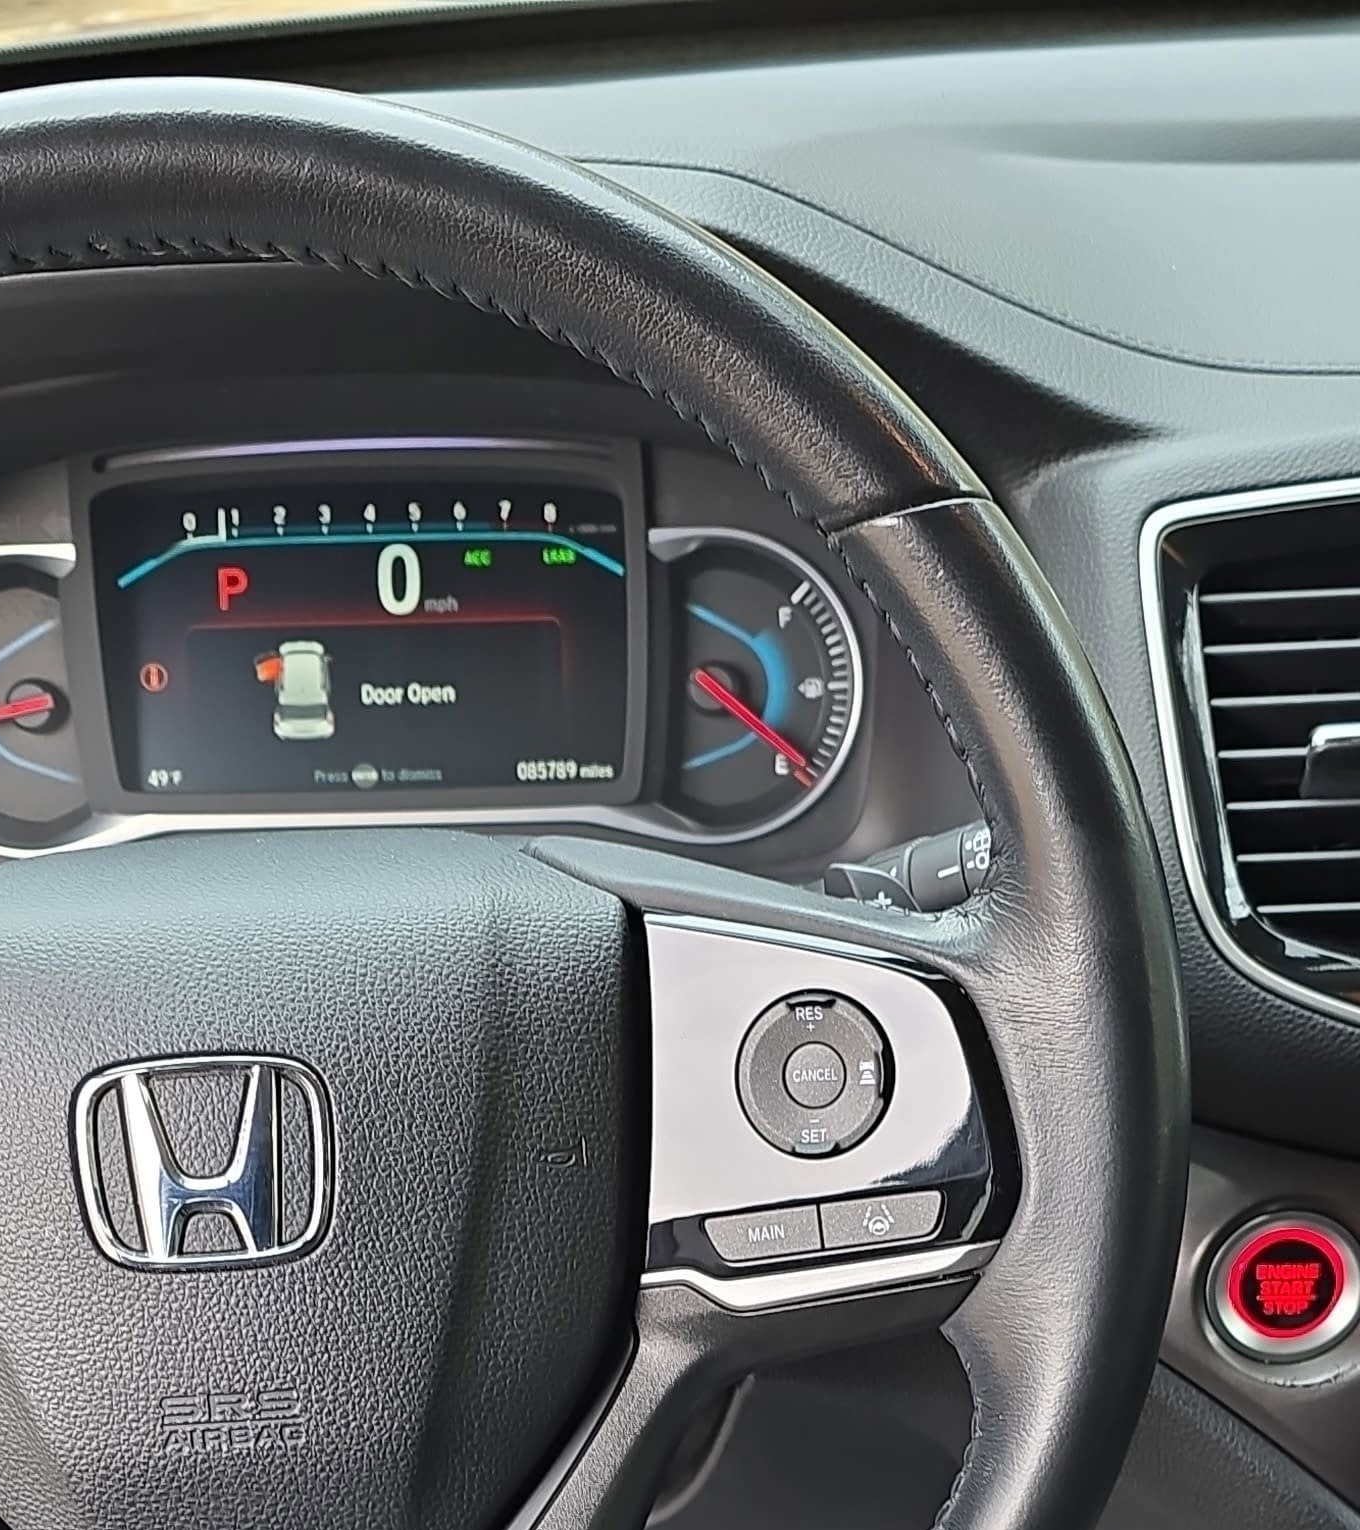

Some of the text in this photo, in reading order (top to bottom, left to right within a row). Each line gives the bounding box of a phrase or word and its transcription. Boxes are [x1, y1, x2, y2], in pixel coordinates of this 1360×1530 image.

[183, 511, 197, 530] 0
[273, 505, 287, 525] 2
[318, 504, 332, 524] 3
[363, 503, 377, 523] 4
[453, 502, 467, 521] 6
[498, 500, 512, 521] 7
[217, 567, 249, 611] P
[377, 543, 422, 616] 0
[778, 606, 792, 629] F
[361, 682, 456, 707] Door Open
[516, 759, 614, 782] 085789 miles
[775, 753, 789, 775] E
[795, 1006, 823, 1021] RES
[792, 1068, 838, 1083] CANCEL
[801, 1128, 827, 1143] SET
[748, 1224, 785, 1243] MAIN
[1255, 1263, 1320, 1280] ENGINE
[1259, 1281, 1315, 1296] START
[1263, 1300, 1308, 1316] STOP
[159, 1390, 300, 1425] SRS
[160, 1428, 306, 1453] AIRBAG
